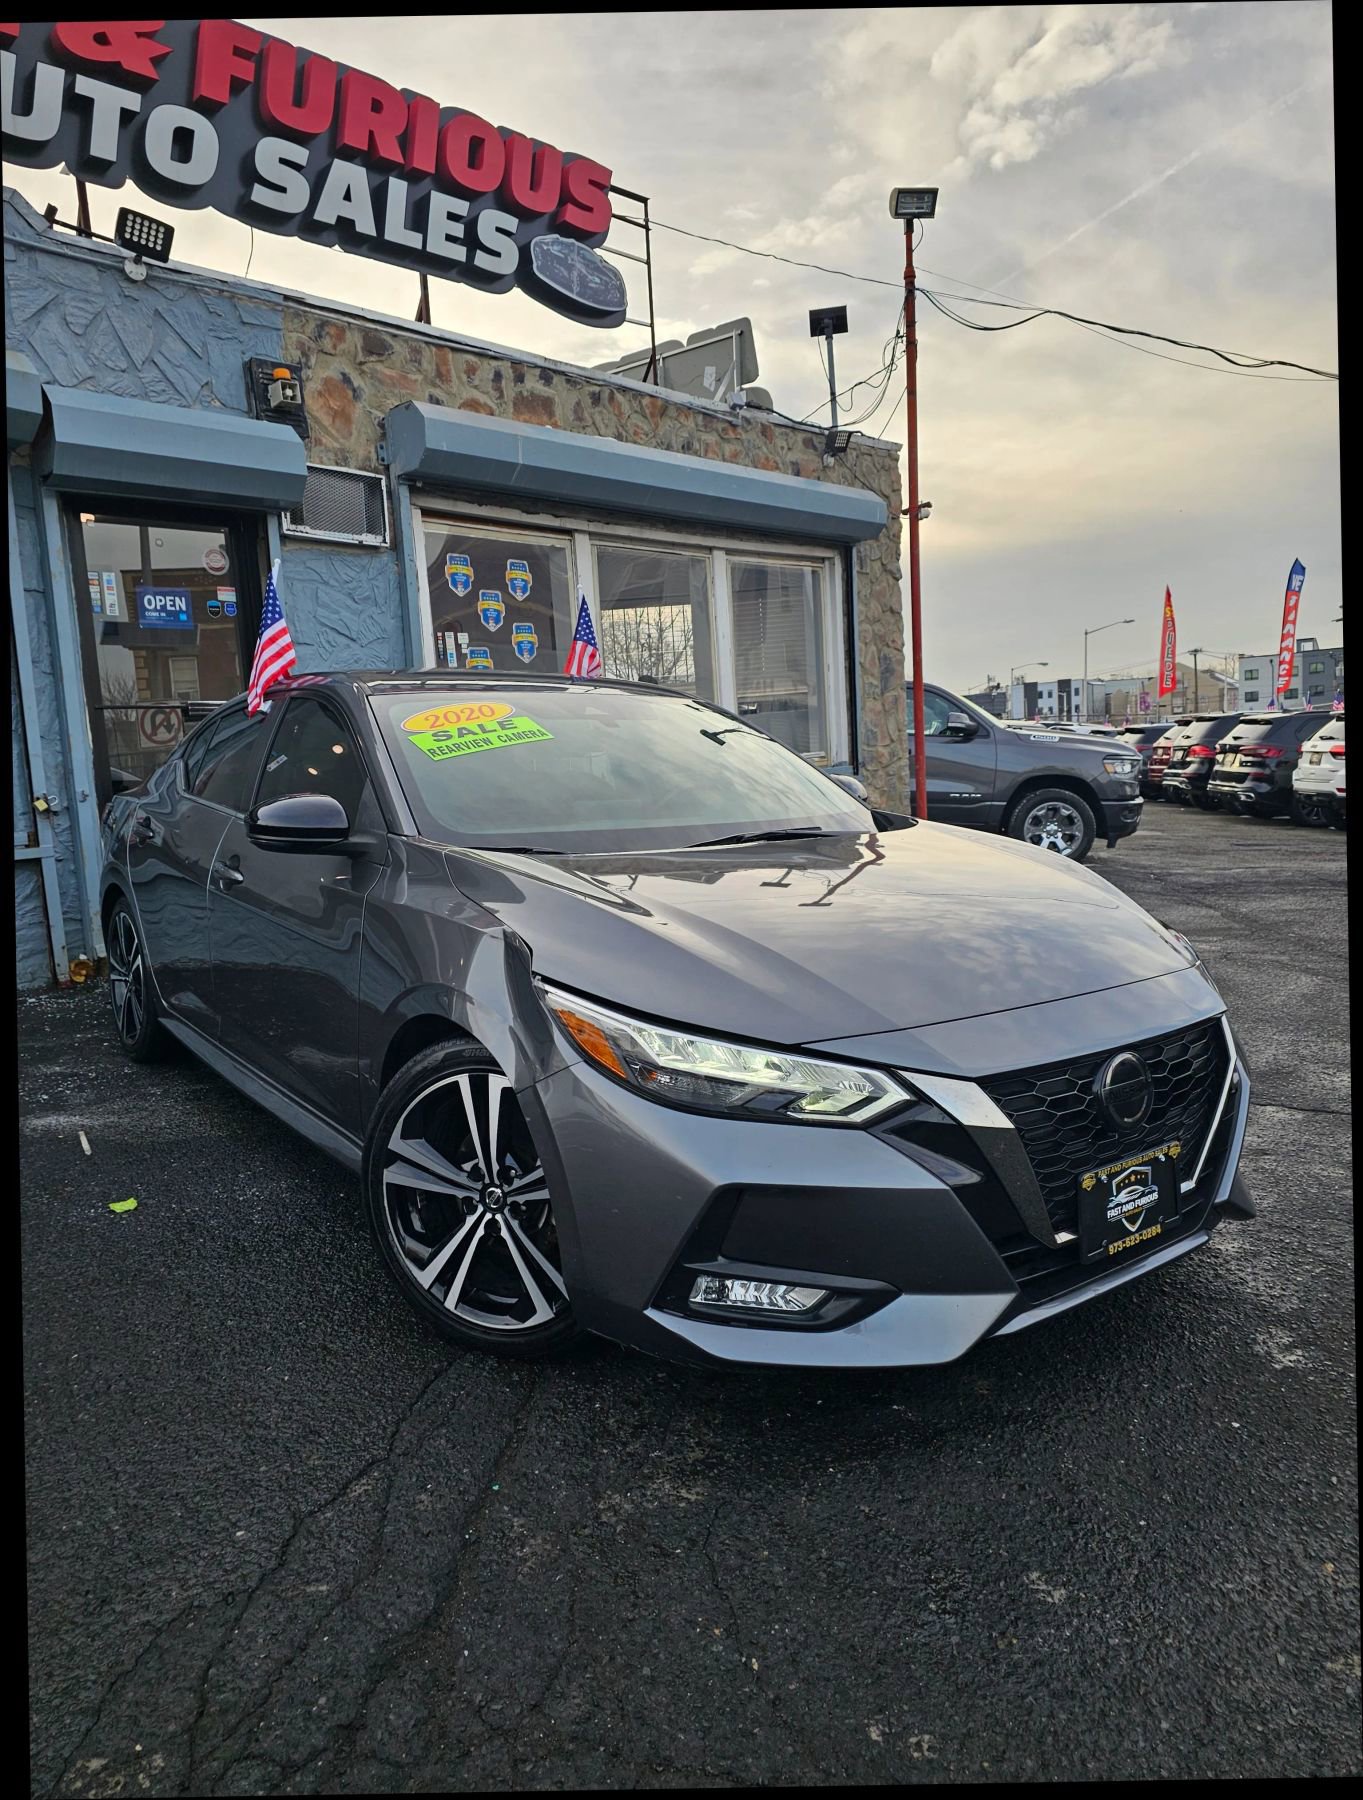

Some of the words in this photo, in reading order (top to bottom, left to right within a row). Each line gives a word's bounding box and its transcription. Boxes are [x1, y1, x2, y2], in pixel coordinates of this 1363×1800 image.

[194, 20, 612, 234] FURIOUS
[251, 136, 520, 276] SALES
[143, 594, 187, 611] OPEN
[424, 704, 496, 729] 2020
[427, 736, 495, 758] REARVIEW
[496, 728, 550, 743] CAMERA
[431, 719, 518, 743] SALE
[1107, 1205, 1122, 1219] FAST
[1122, 1201, 1135, 1213] AND
[1135, 1191, 1159, 1207] FURIOUS
